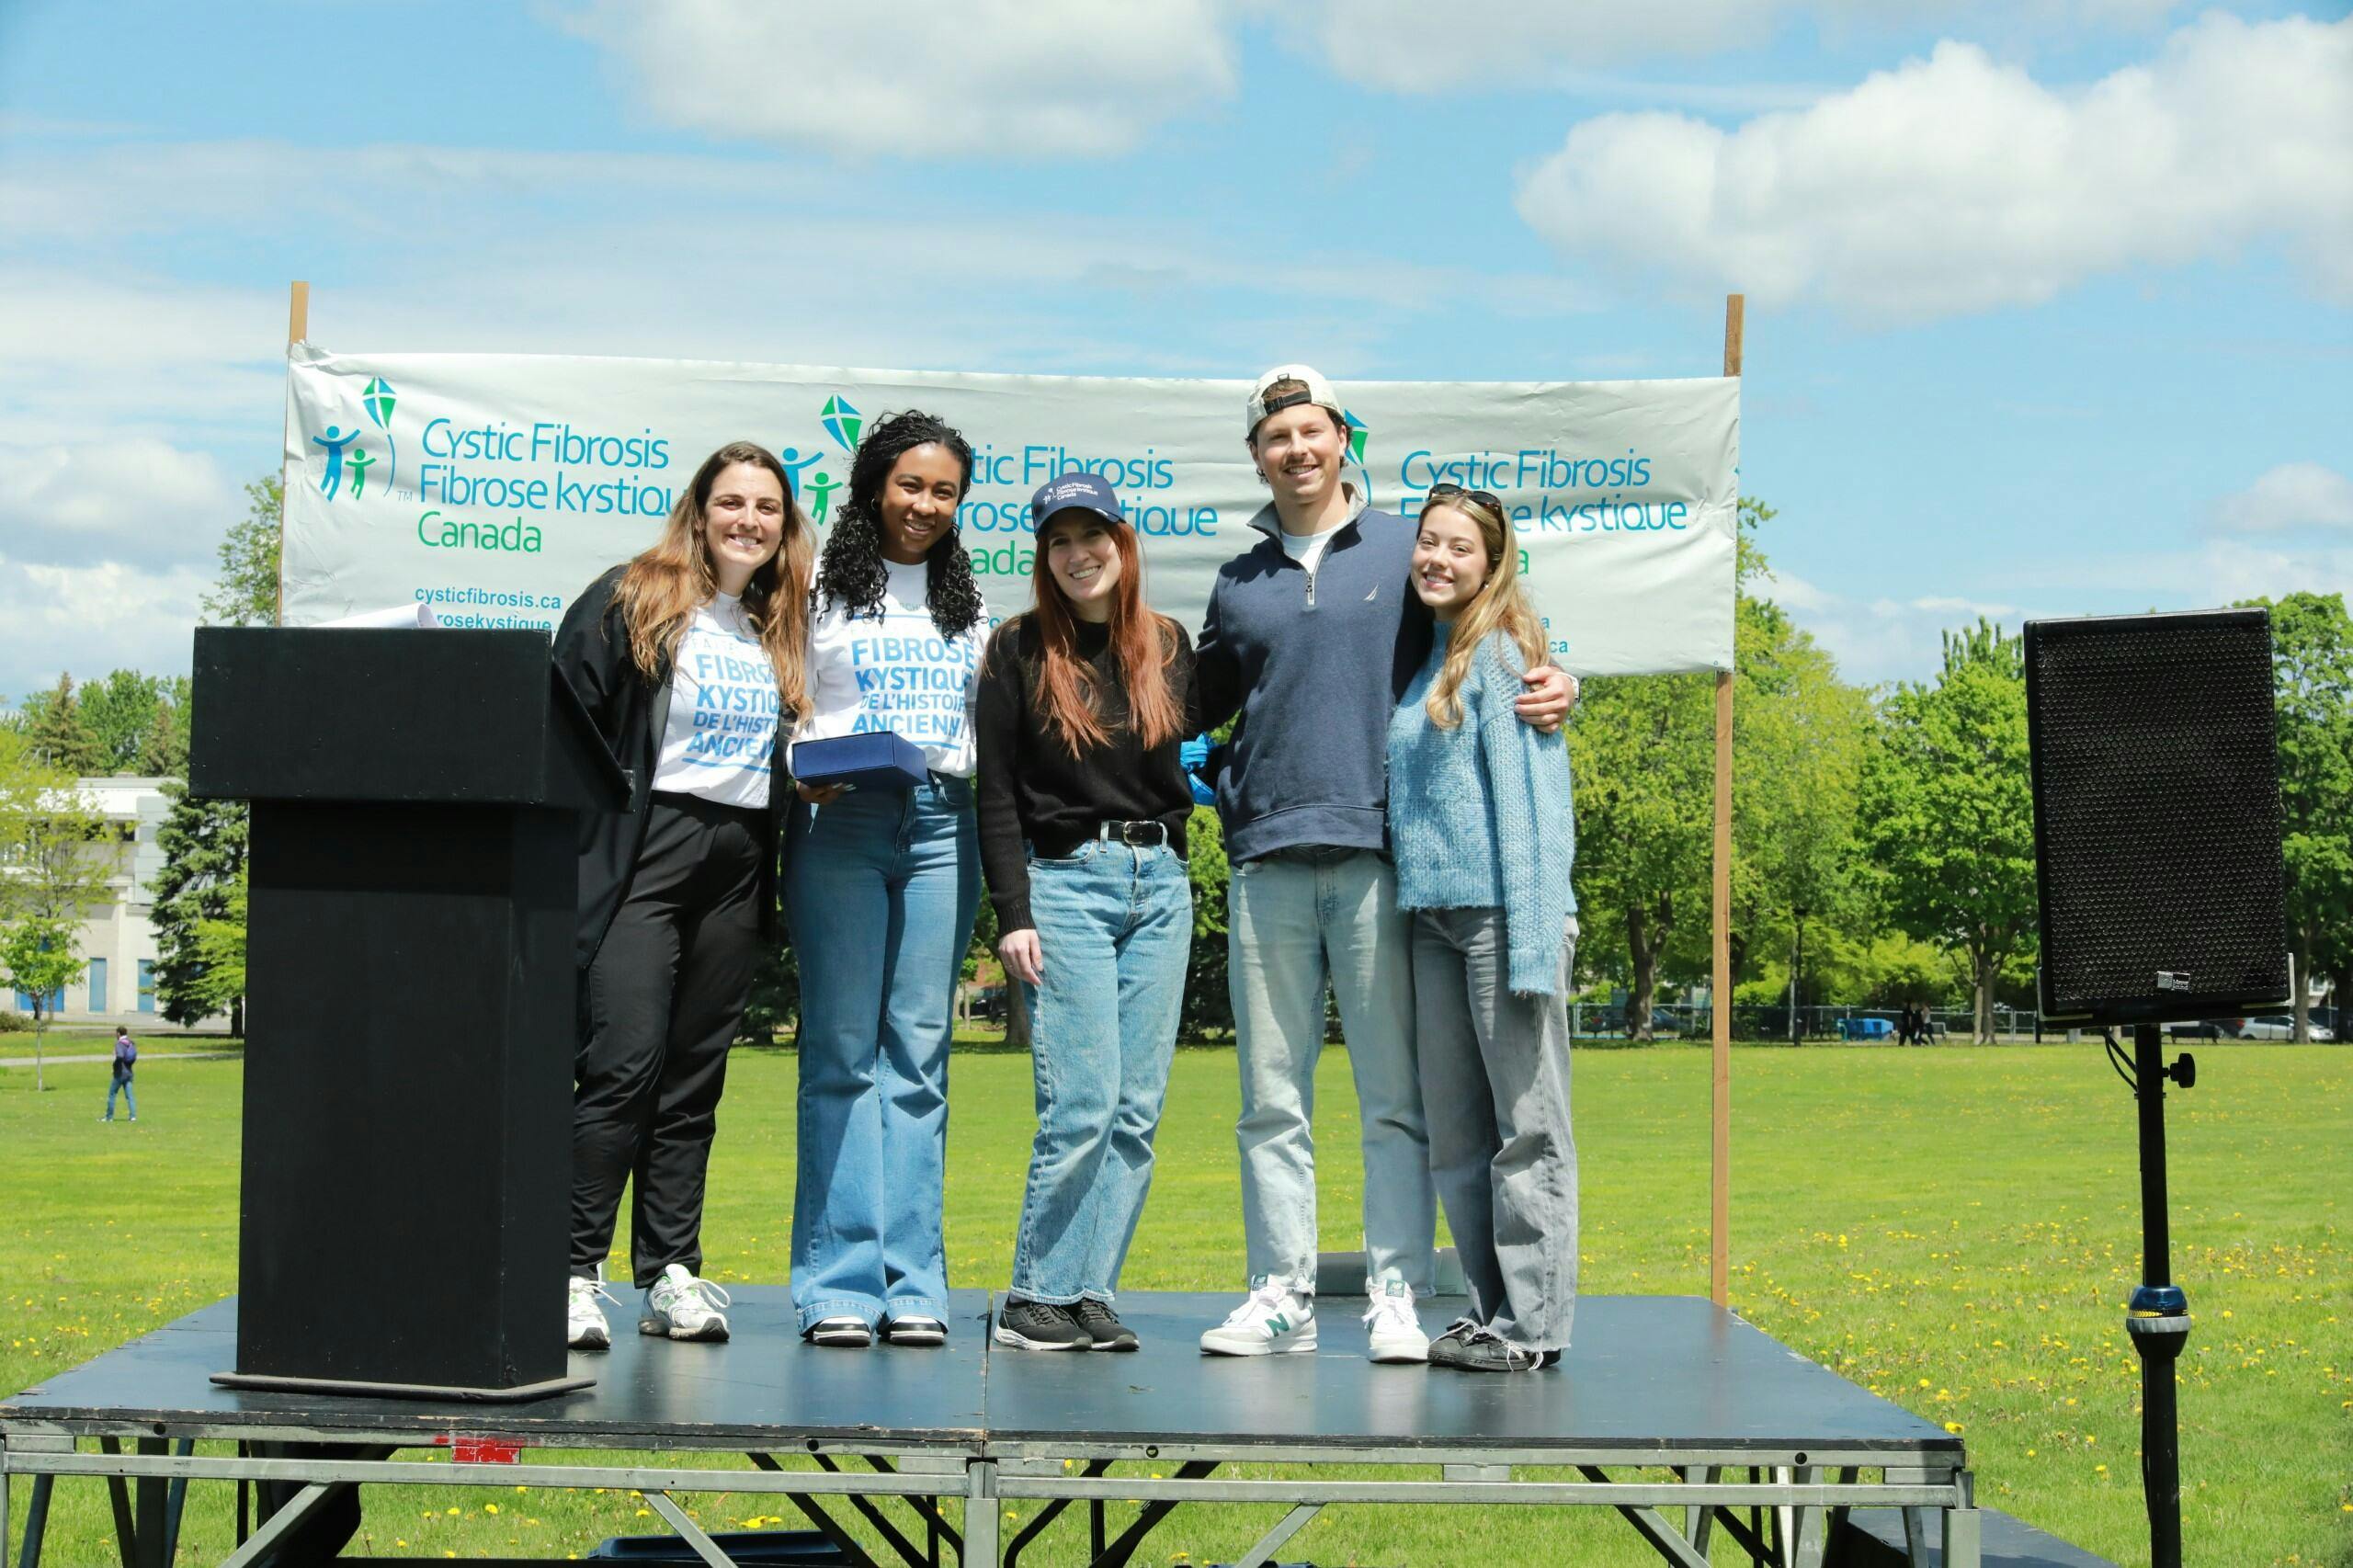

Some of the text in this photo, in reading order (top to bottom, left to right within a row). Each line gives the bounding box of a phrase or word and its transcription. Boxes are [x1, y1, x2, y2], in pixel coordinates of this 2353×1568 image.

[422, 418, 669, 470] Cystic Fibrosis
[971, 445, 1015, 485] tic
[1401, 448, 1651, 490] Cystic Fibrosis
[420, 464, 549, 509] Fibrose
[957, 495, 1218, 536] rose tique
[1540, 494, 1688, 532] kystique
[417, 511, 542, 552] Canada
[971, 540, 1034, 576] ada
[415, 586, 562, 609] cysticfibrosis.ca
[696, 653, 773, 685] FIBRO
[855, 666, 965, 692] KYSTIQU
[697, 684, 779, 714] KYSTIQ
[882, 693, 966, 713] L'HISTOIR
[693, 710, 774, 734] DE L'HIST
[851, 714, 963, 738] ANCIENN
[686, 731, 776, 760] ANCIEN
